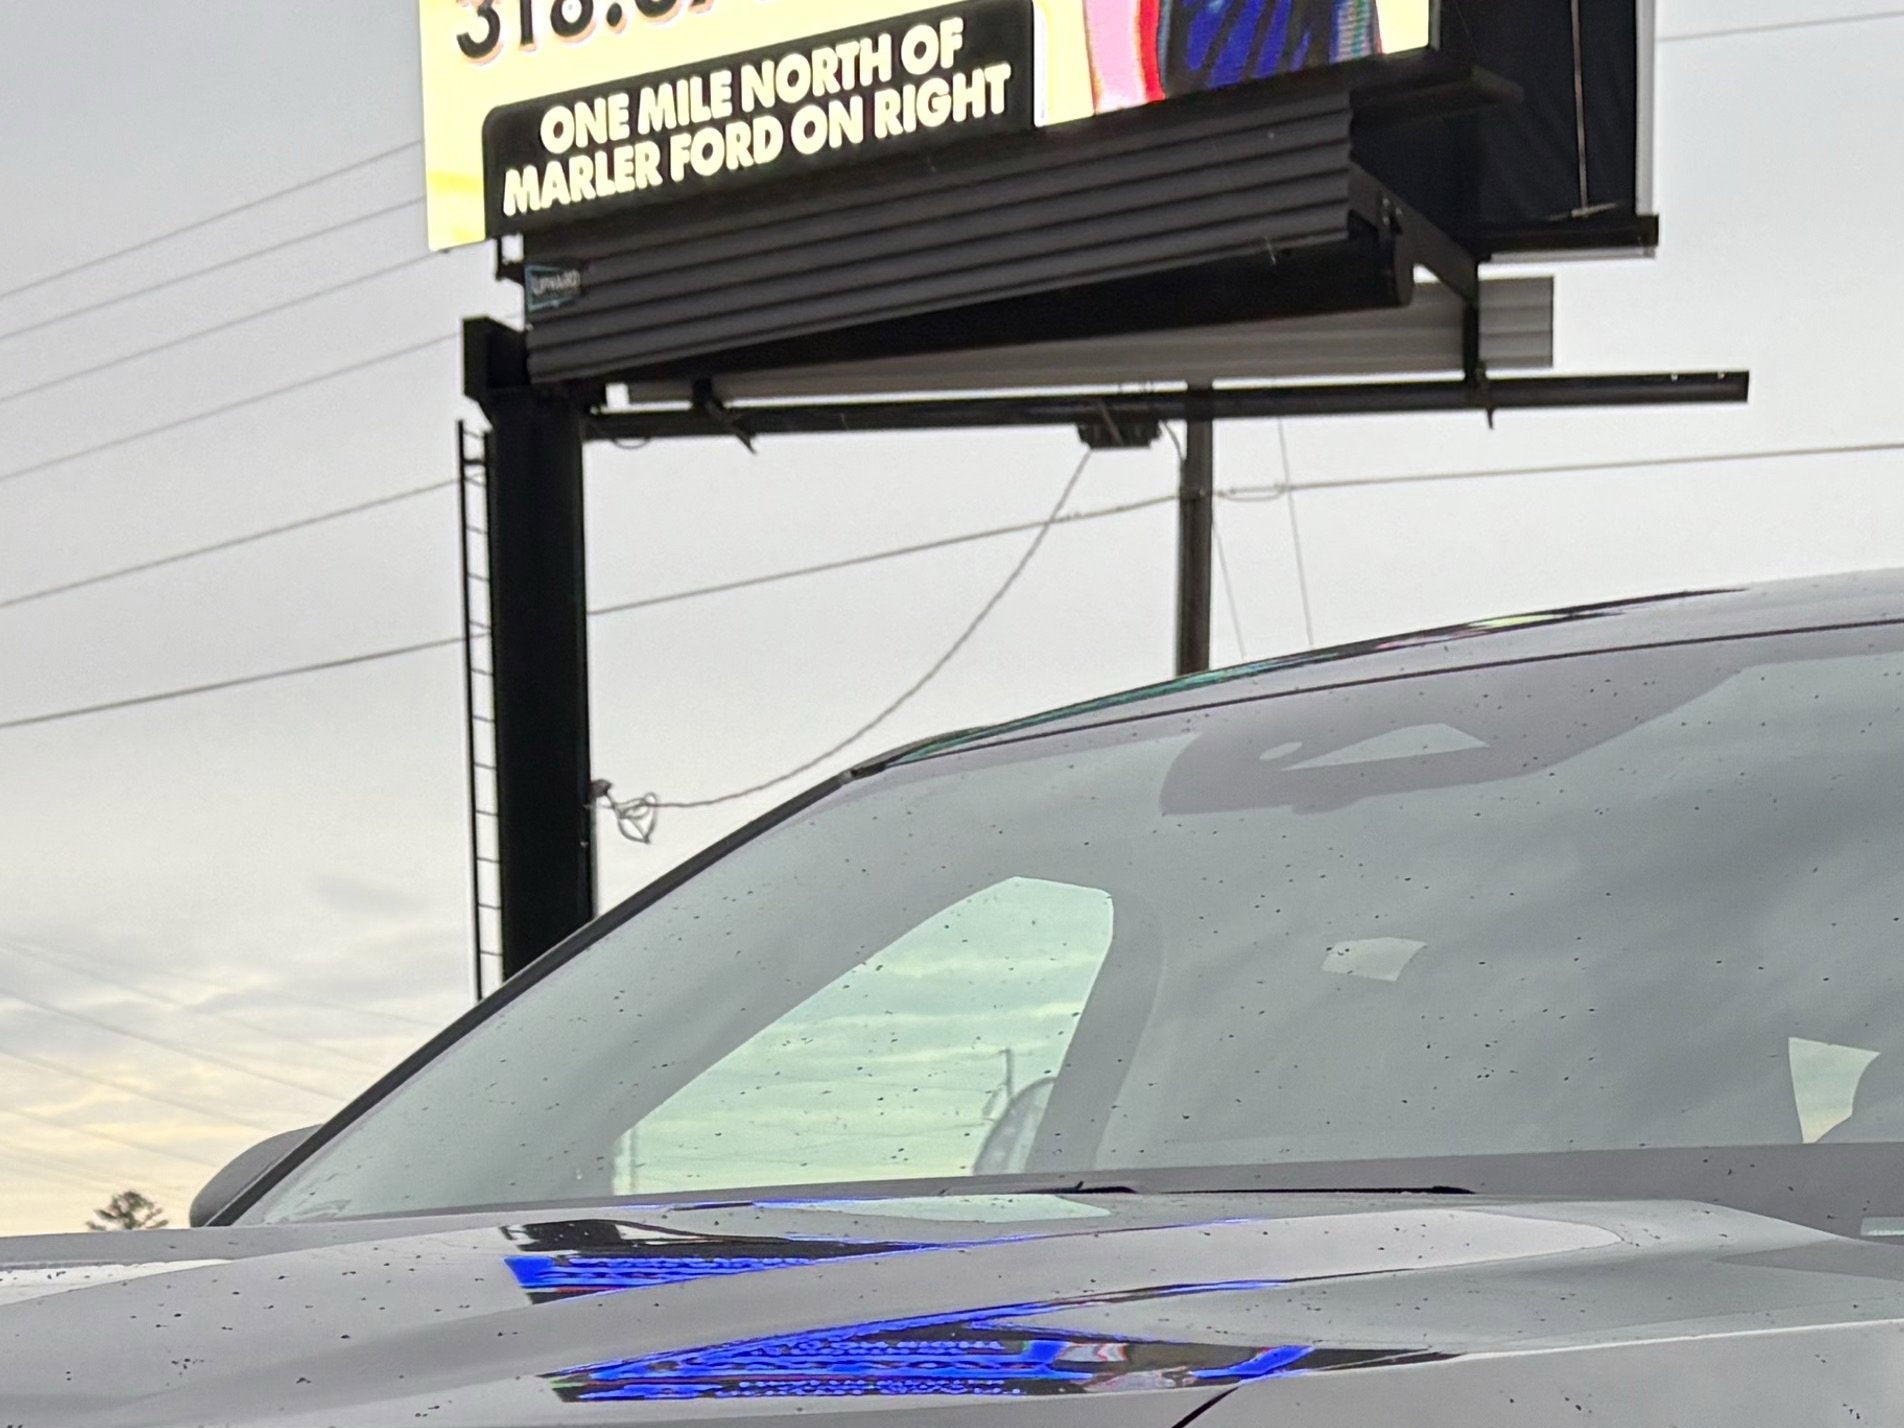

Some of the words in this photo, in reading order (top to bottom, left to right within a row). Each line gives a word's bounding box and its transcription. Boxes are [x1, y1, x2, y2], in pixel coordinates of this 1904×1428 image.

[502, 141, 663, 216] MARLER
[670, 115, 784, 182] FORD
[791, 96, 864, 155] ON
[874, 62, 1011, 139] RIGHT
[540, 93, 630, 154] ONE
[637, 70, 733, 135] MILE
[740, 33, 892, 113] NORTH
[901, 17, 964, 75] OF
